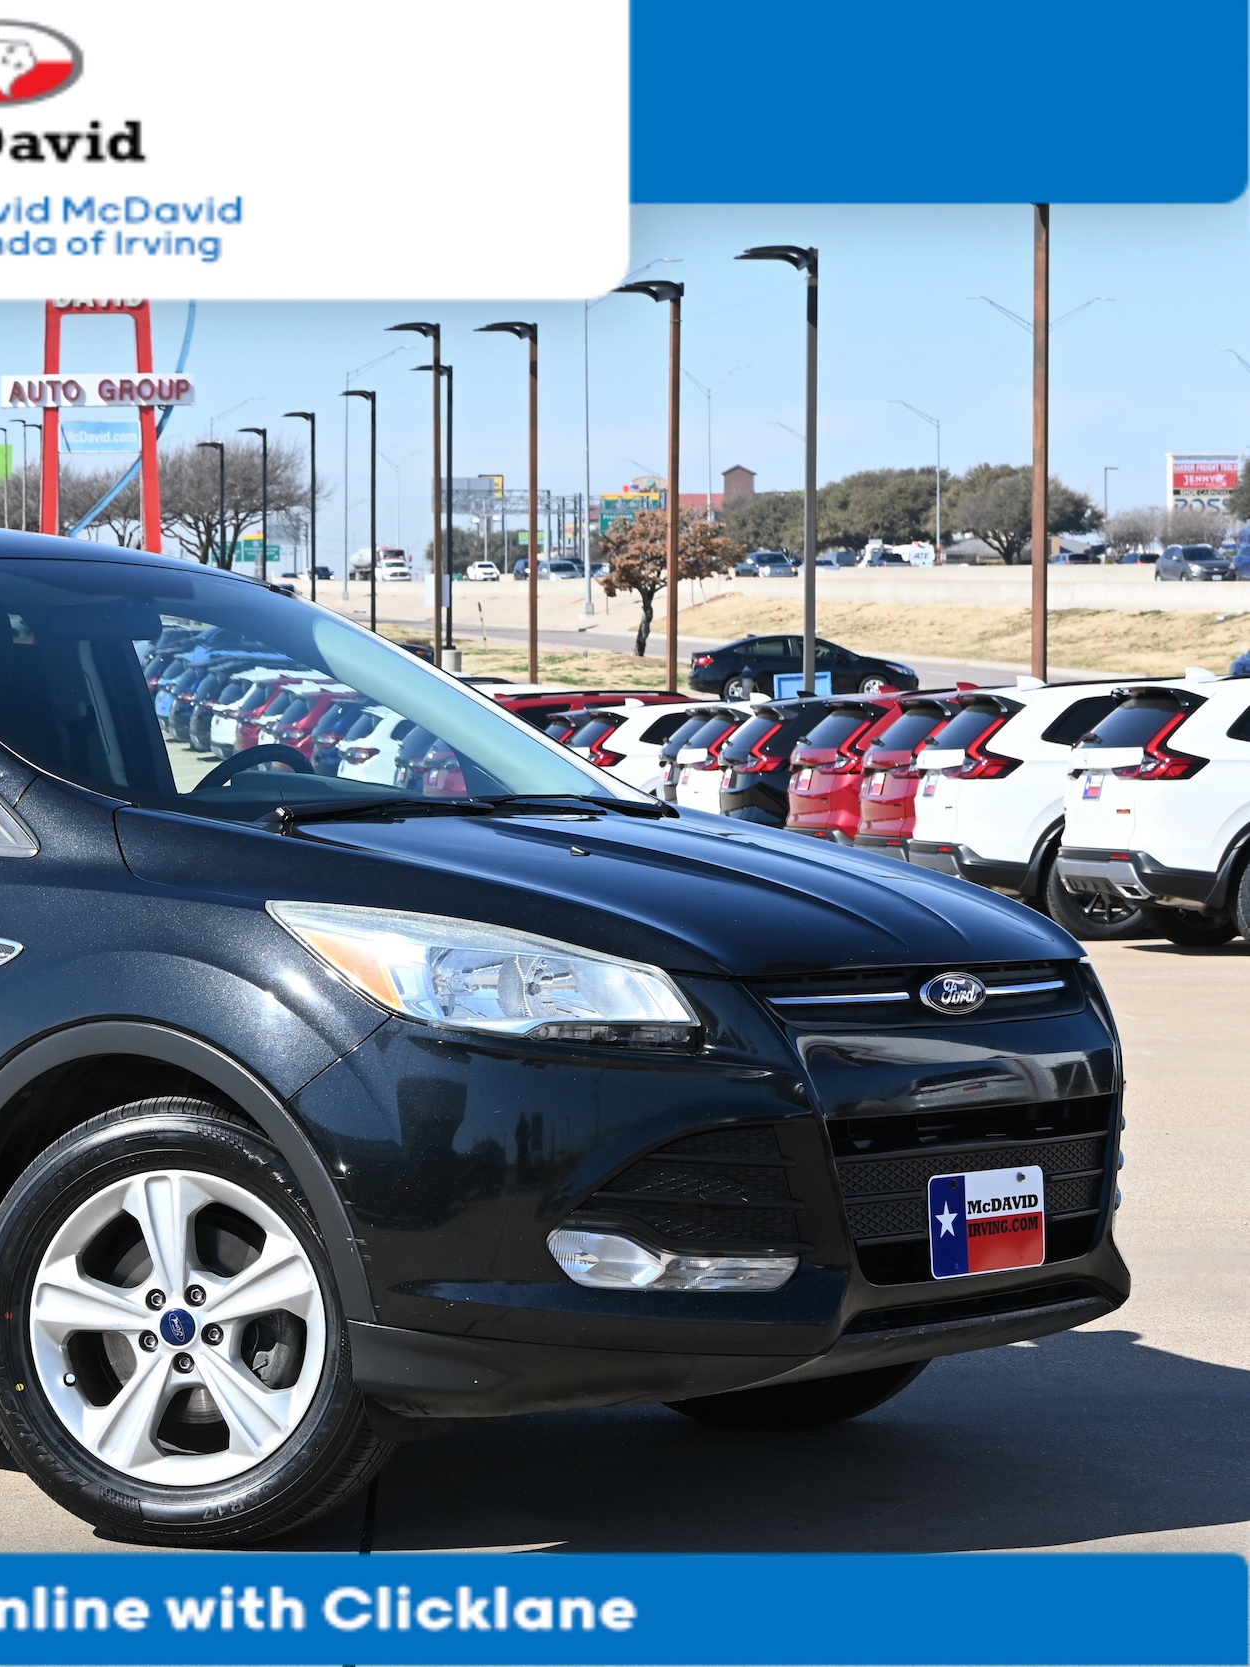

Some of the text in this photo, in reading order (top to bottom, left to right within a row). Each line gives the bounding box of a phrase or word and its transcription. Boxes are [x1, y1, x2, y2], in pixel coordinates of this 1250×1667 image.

[9, 378, 190, 403] AUTO GROUP
[941, 979, 976, 1005] Ford
[967, 1194, 1038, 1214] McDAVID
[968, 1216, 1039, 1237] IRVING.COM
